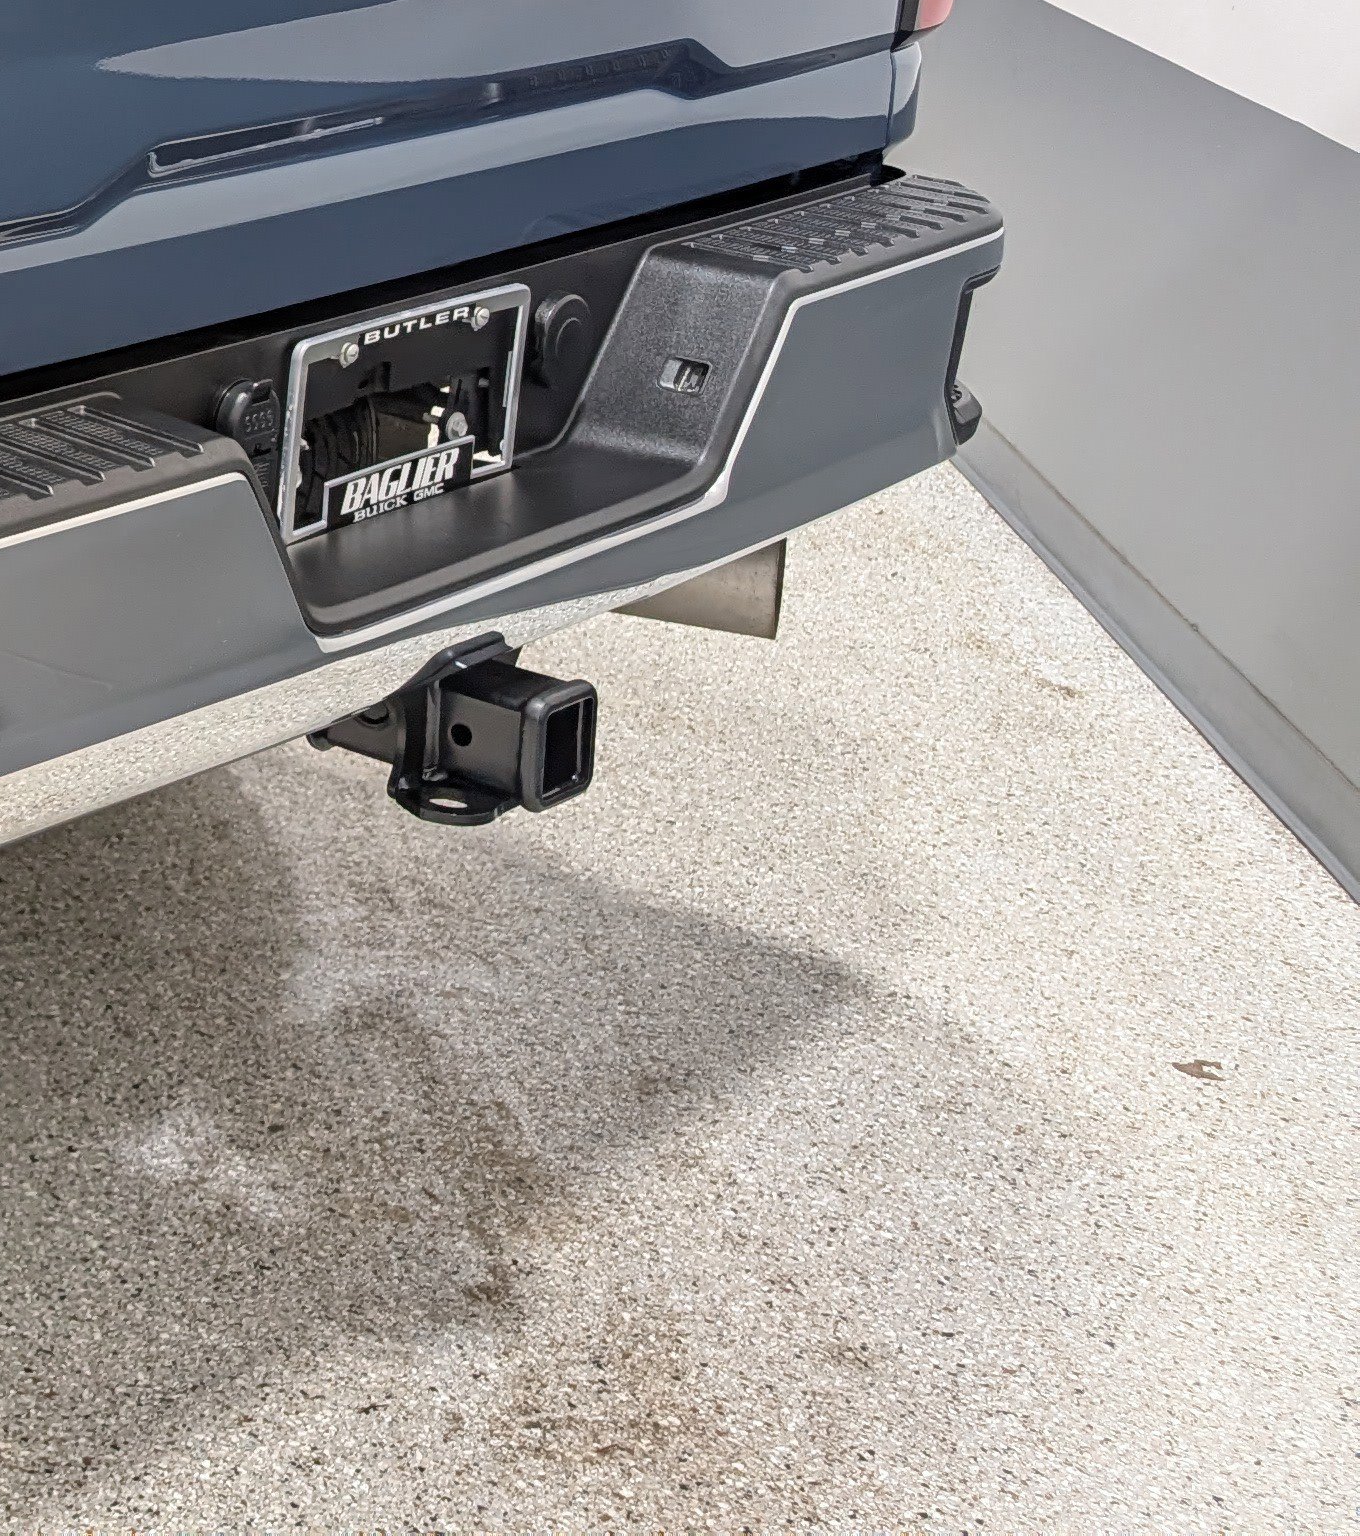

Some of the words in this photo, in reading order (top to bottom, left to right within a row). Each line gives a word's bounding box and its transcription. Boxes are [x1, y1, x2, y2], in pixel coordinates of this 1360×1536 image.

[363, 306, 470, 346] BUTLER
[340, 447, 460, 516] BAGLIER
[353, 494, 409, 523] BUICK
[413, 482, 445, 502] GMC
